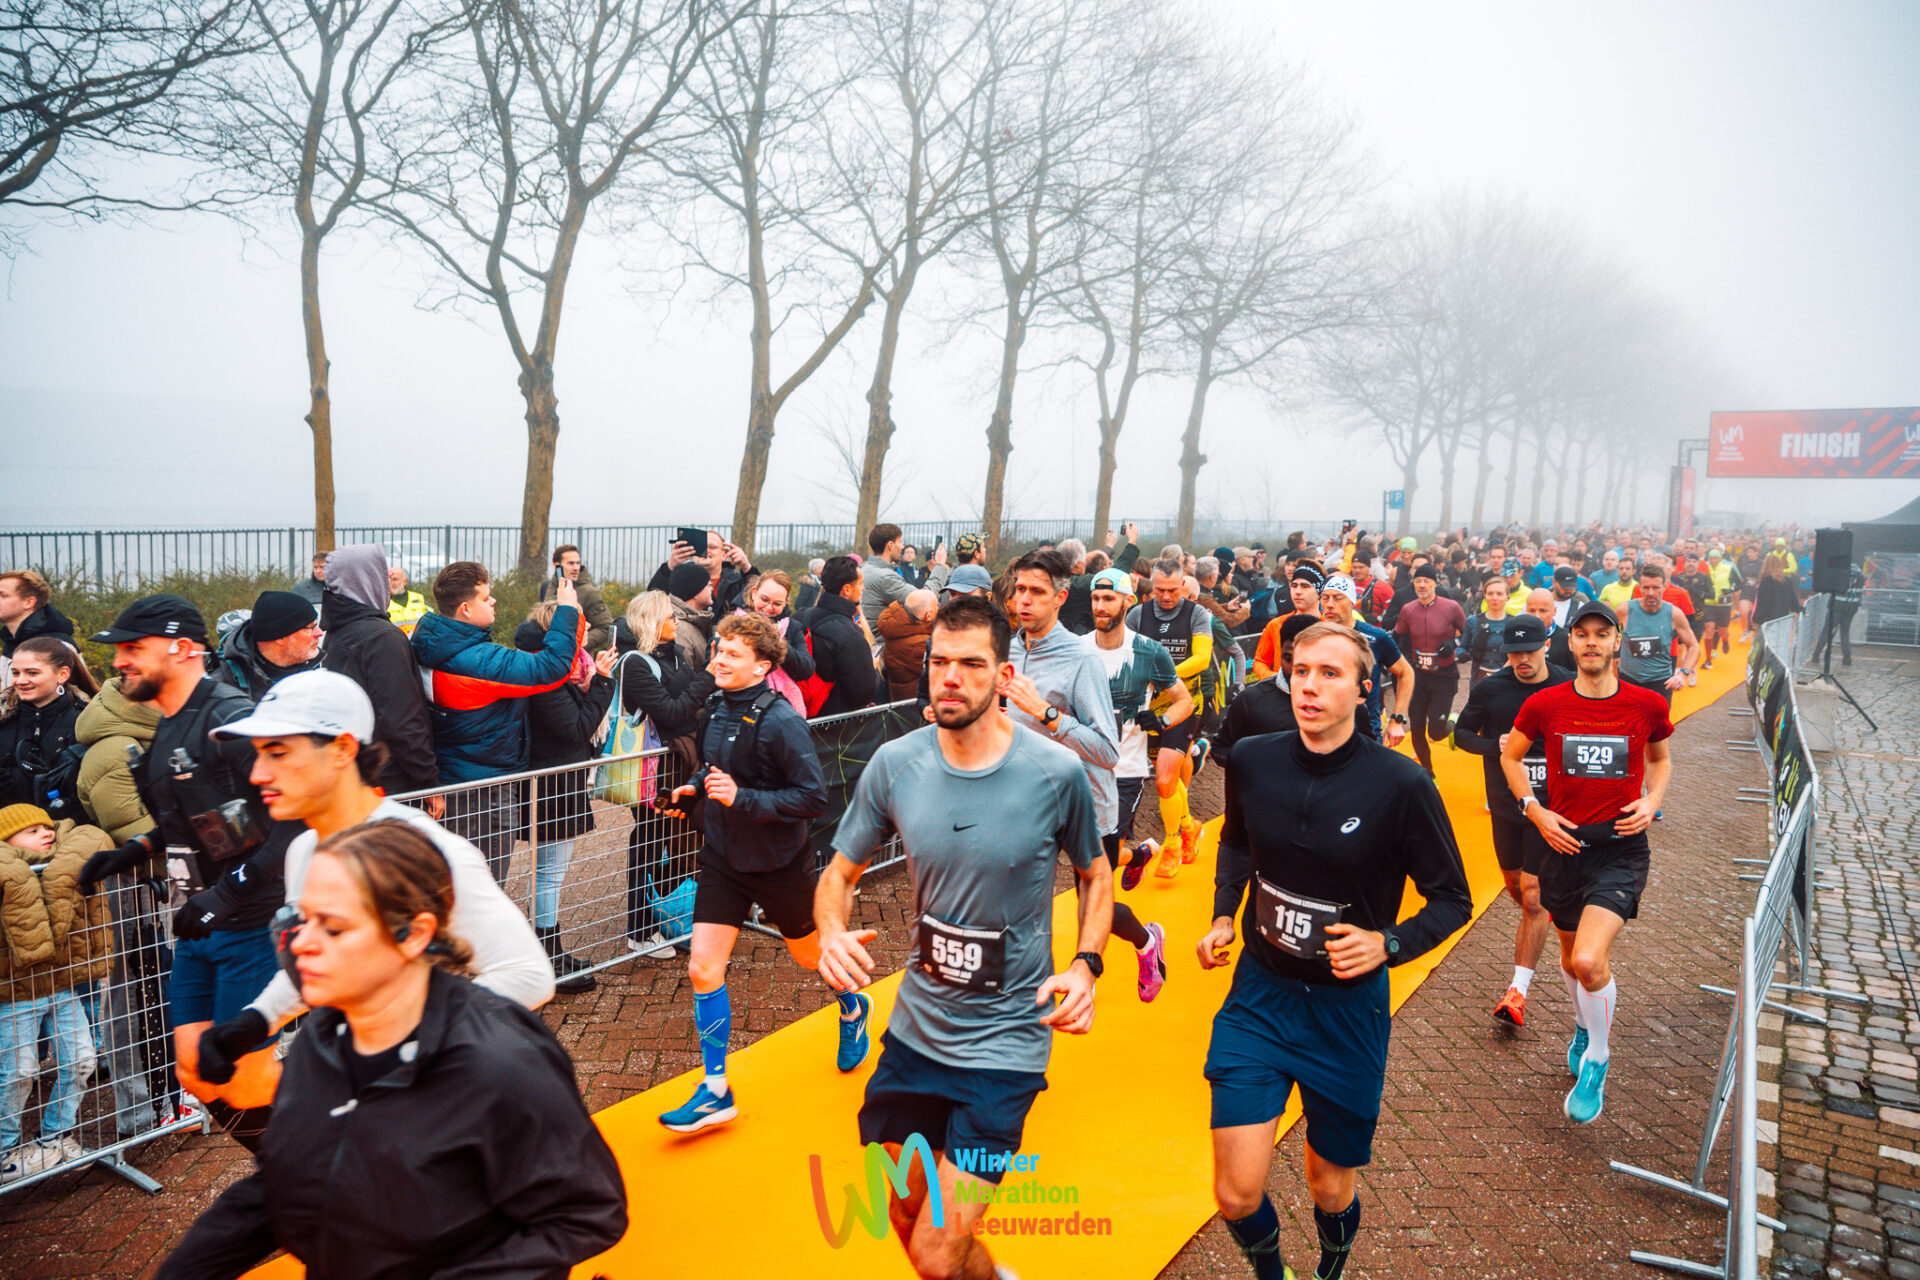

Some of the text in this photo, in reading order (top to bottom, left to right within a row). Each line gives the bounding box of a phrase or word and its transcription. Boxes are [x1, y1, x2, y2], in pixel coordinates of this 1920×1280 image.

[1780, 432, 1861, 458] FINISH
[1577, 745, 1613, 765] 529
[1523, 765, 1547, 781] 18
[1275, 904, 1312, 939] 115
[932, 934, 982, 972] 559
